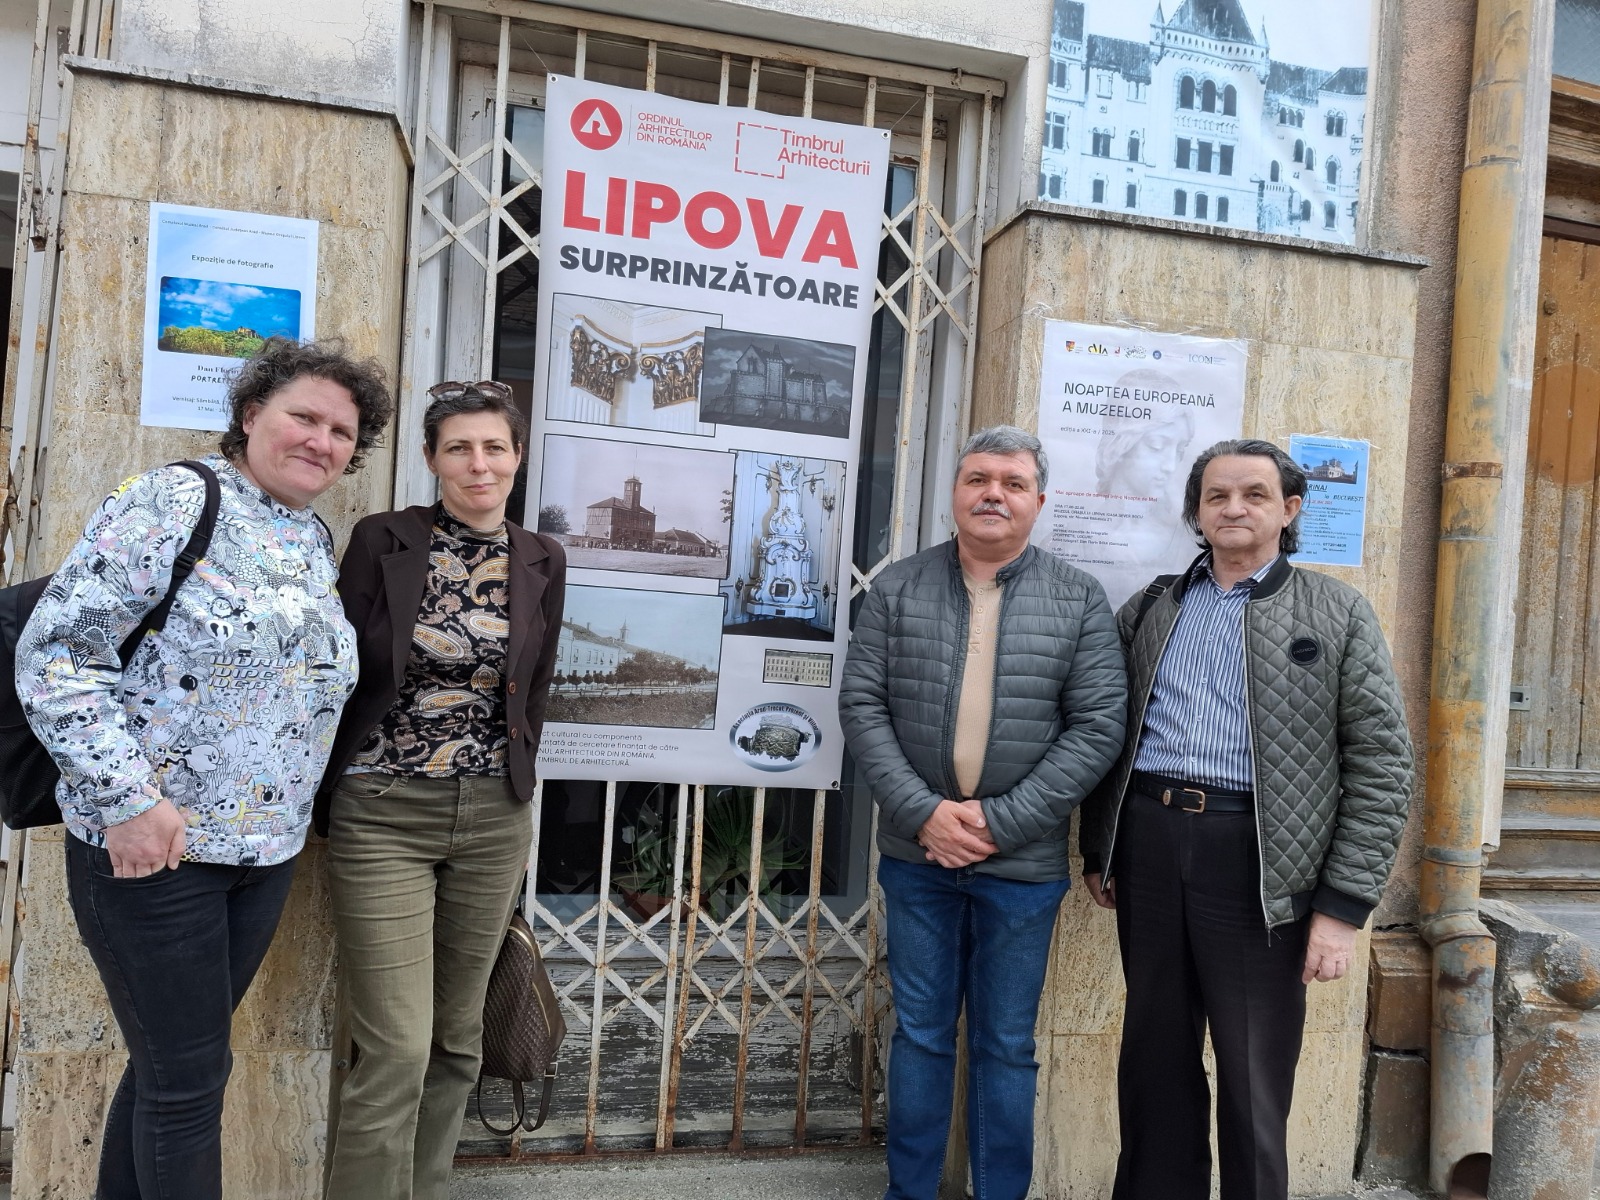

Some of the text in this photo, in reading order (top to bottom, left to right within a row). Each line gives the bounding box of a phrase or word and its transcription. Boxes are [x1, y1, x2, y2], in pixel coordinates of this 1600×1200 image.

[638, 112, 684, 127] ORDINUL
[637, 132, 707, 151] DIN ROMÂNIA
[780, 128, 844, 154] Timbrul
[777, 147, 871, 176] Arhitecturii
[563, 169, 859, 269] LIPOVA
[237, 260, 274, 270] fotografie
[559, 244, 859, 309] SURPRINZĂTOARE
[1064, 382, 1215, 408] NOAPTEA EUROPEANĂ
[1062, 401, 1152, 420] A MUZEELOR
[579, 741, 616, 749] cercetare
[593, 733, 642, 741] componentă
[538, 756, 567, 764] TIMBRUL
